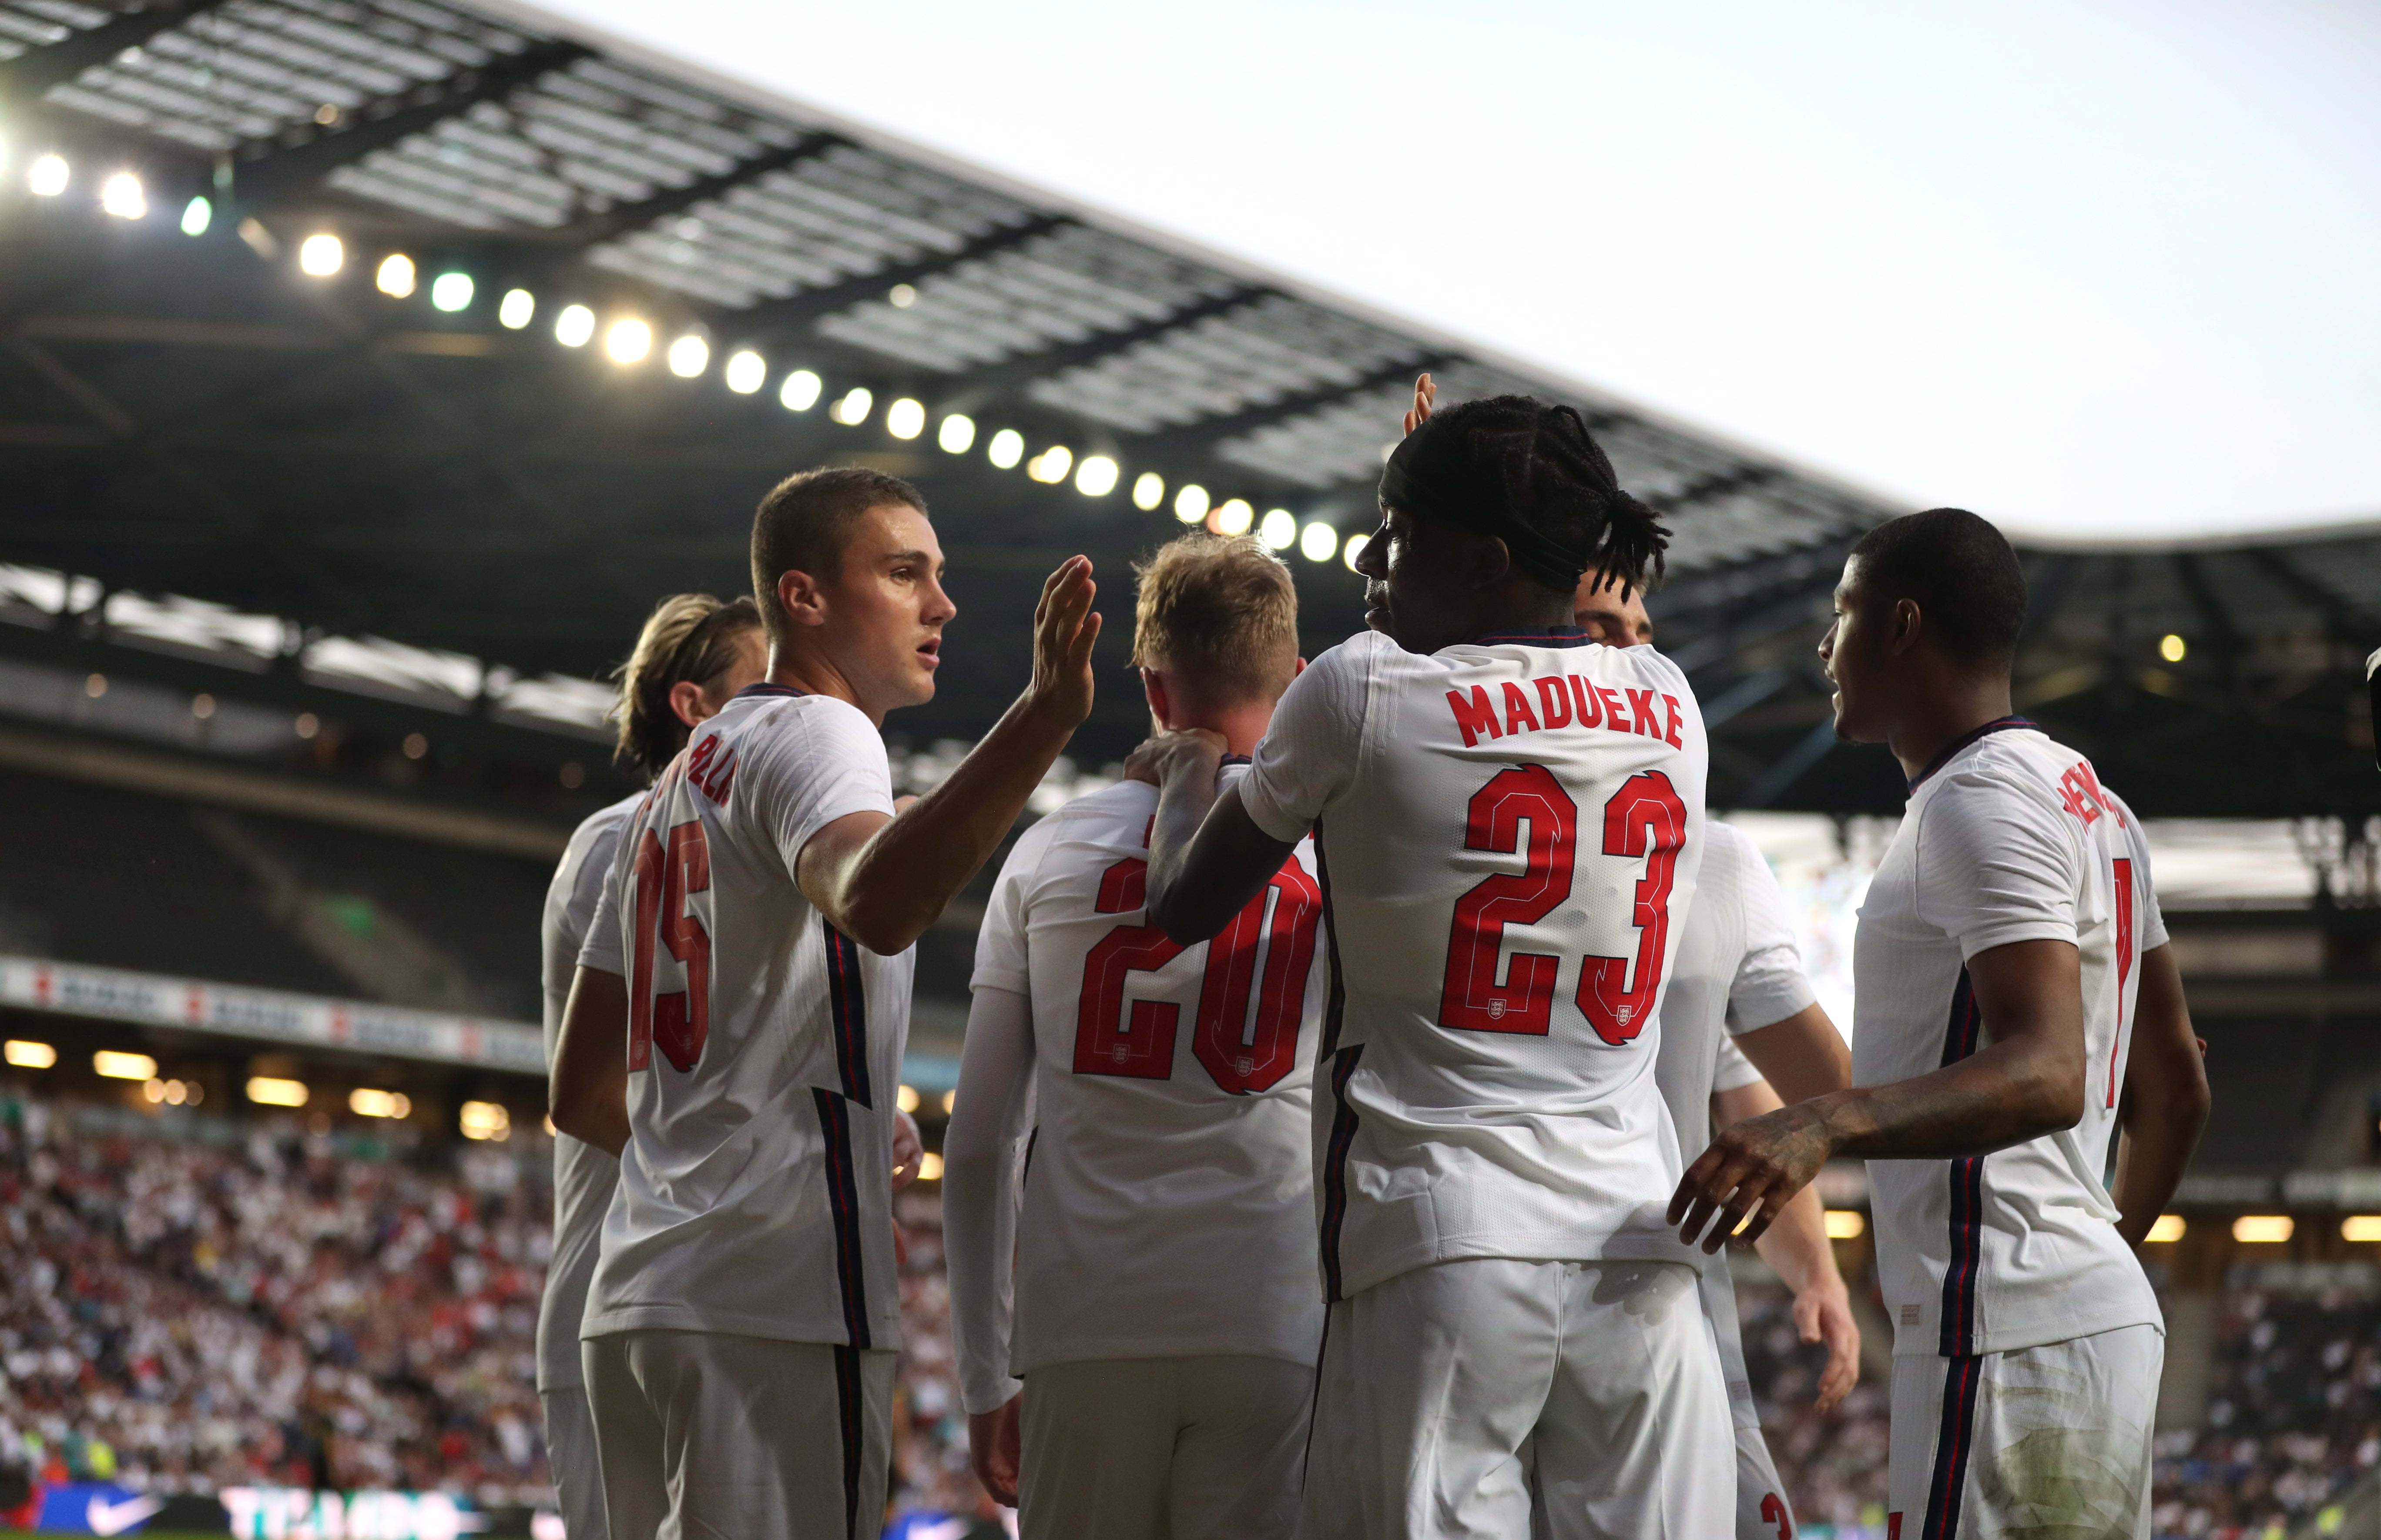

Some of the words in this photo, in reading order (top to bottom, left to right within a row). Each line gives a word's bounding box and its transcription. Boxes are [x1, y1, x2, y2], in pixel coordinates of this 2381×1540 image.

[1445, 674, 1683, 751] MADUEKE
[627, 815, 711, 1073] 15
[1073, 855, 1323, 1095] 20
[1438, 763, 1687, 1046] 23
